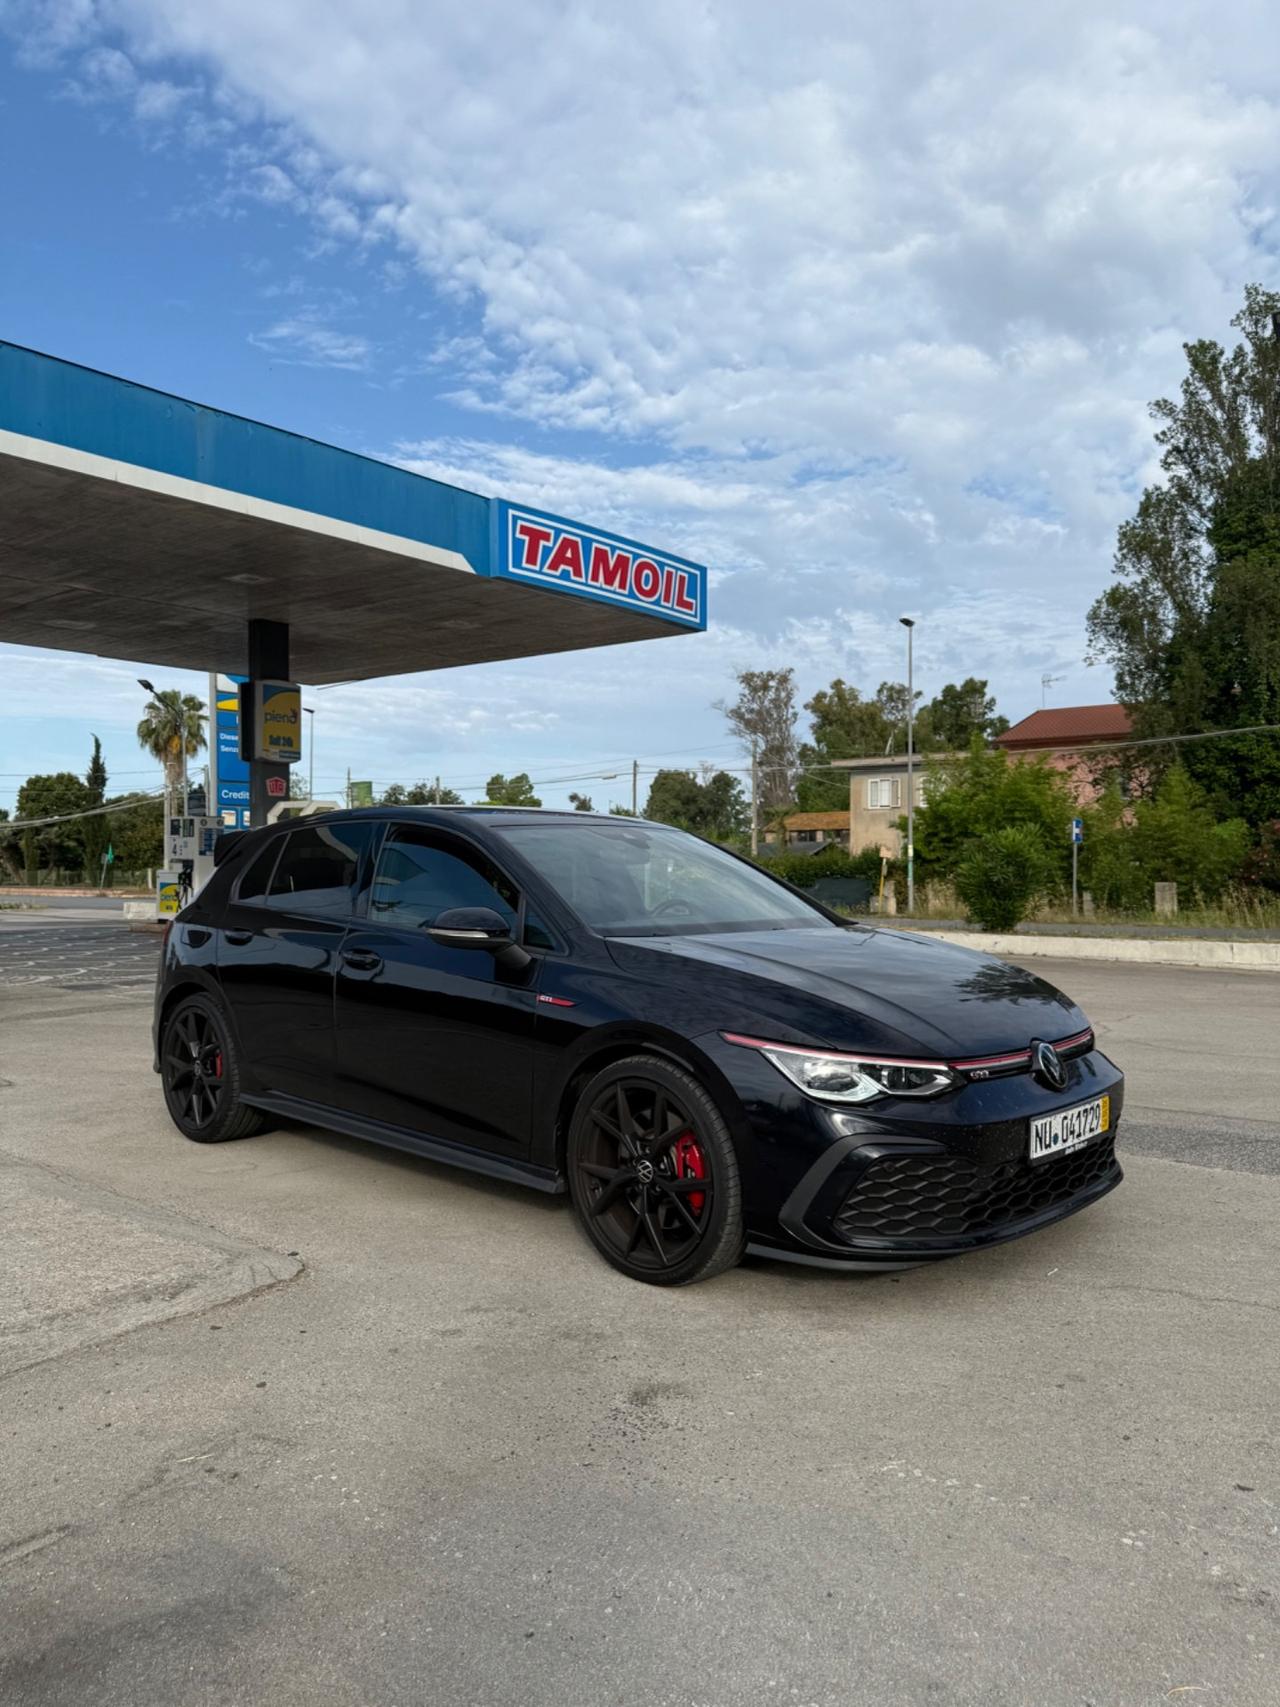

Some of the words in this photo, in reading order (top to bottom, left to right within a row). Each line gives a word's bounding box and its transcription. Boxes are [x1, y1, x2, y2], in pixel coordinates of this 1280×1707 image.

[517, 521, 696, 614] TAMOIL
[1034, 1121, 1052, 1154] NU
[1061, 1102, 1100, 1144] 041729
